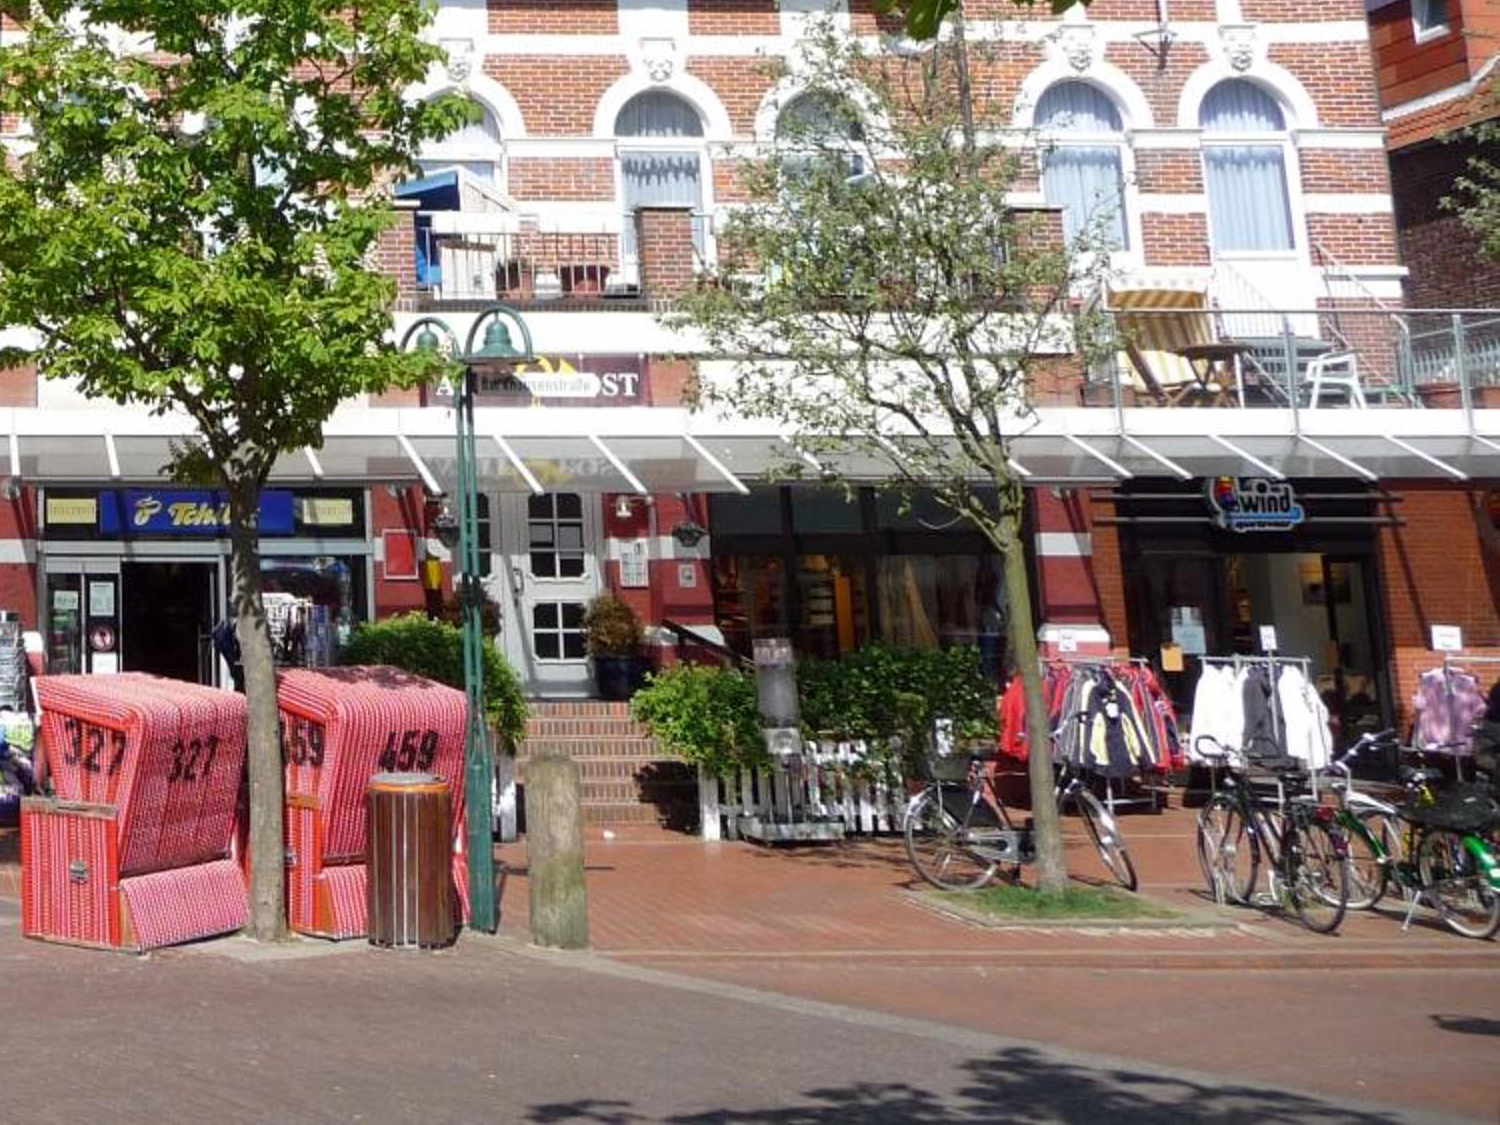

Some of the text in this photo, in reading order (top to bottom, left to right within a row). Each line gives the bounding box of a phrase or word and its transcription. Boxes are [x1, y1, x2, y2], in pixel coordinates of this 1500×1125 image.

[167, 502, 260, 526] Tchi
[63, 718, 128, 776] 327
[169, 733, 220, 783] 327
[278, 716, 326, 768] 59
[378, 728, 440, 772] 459
